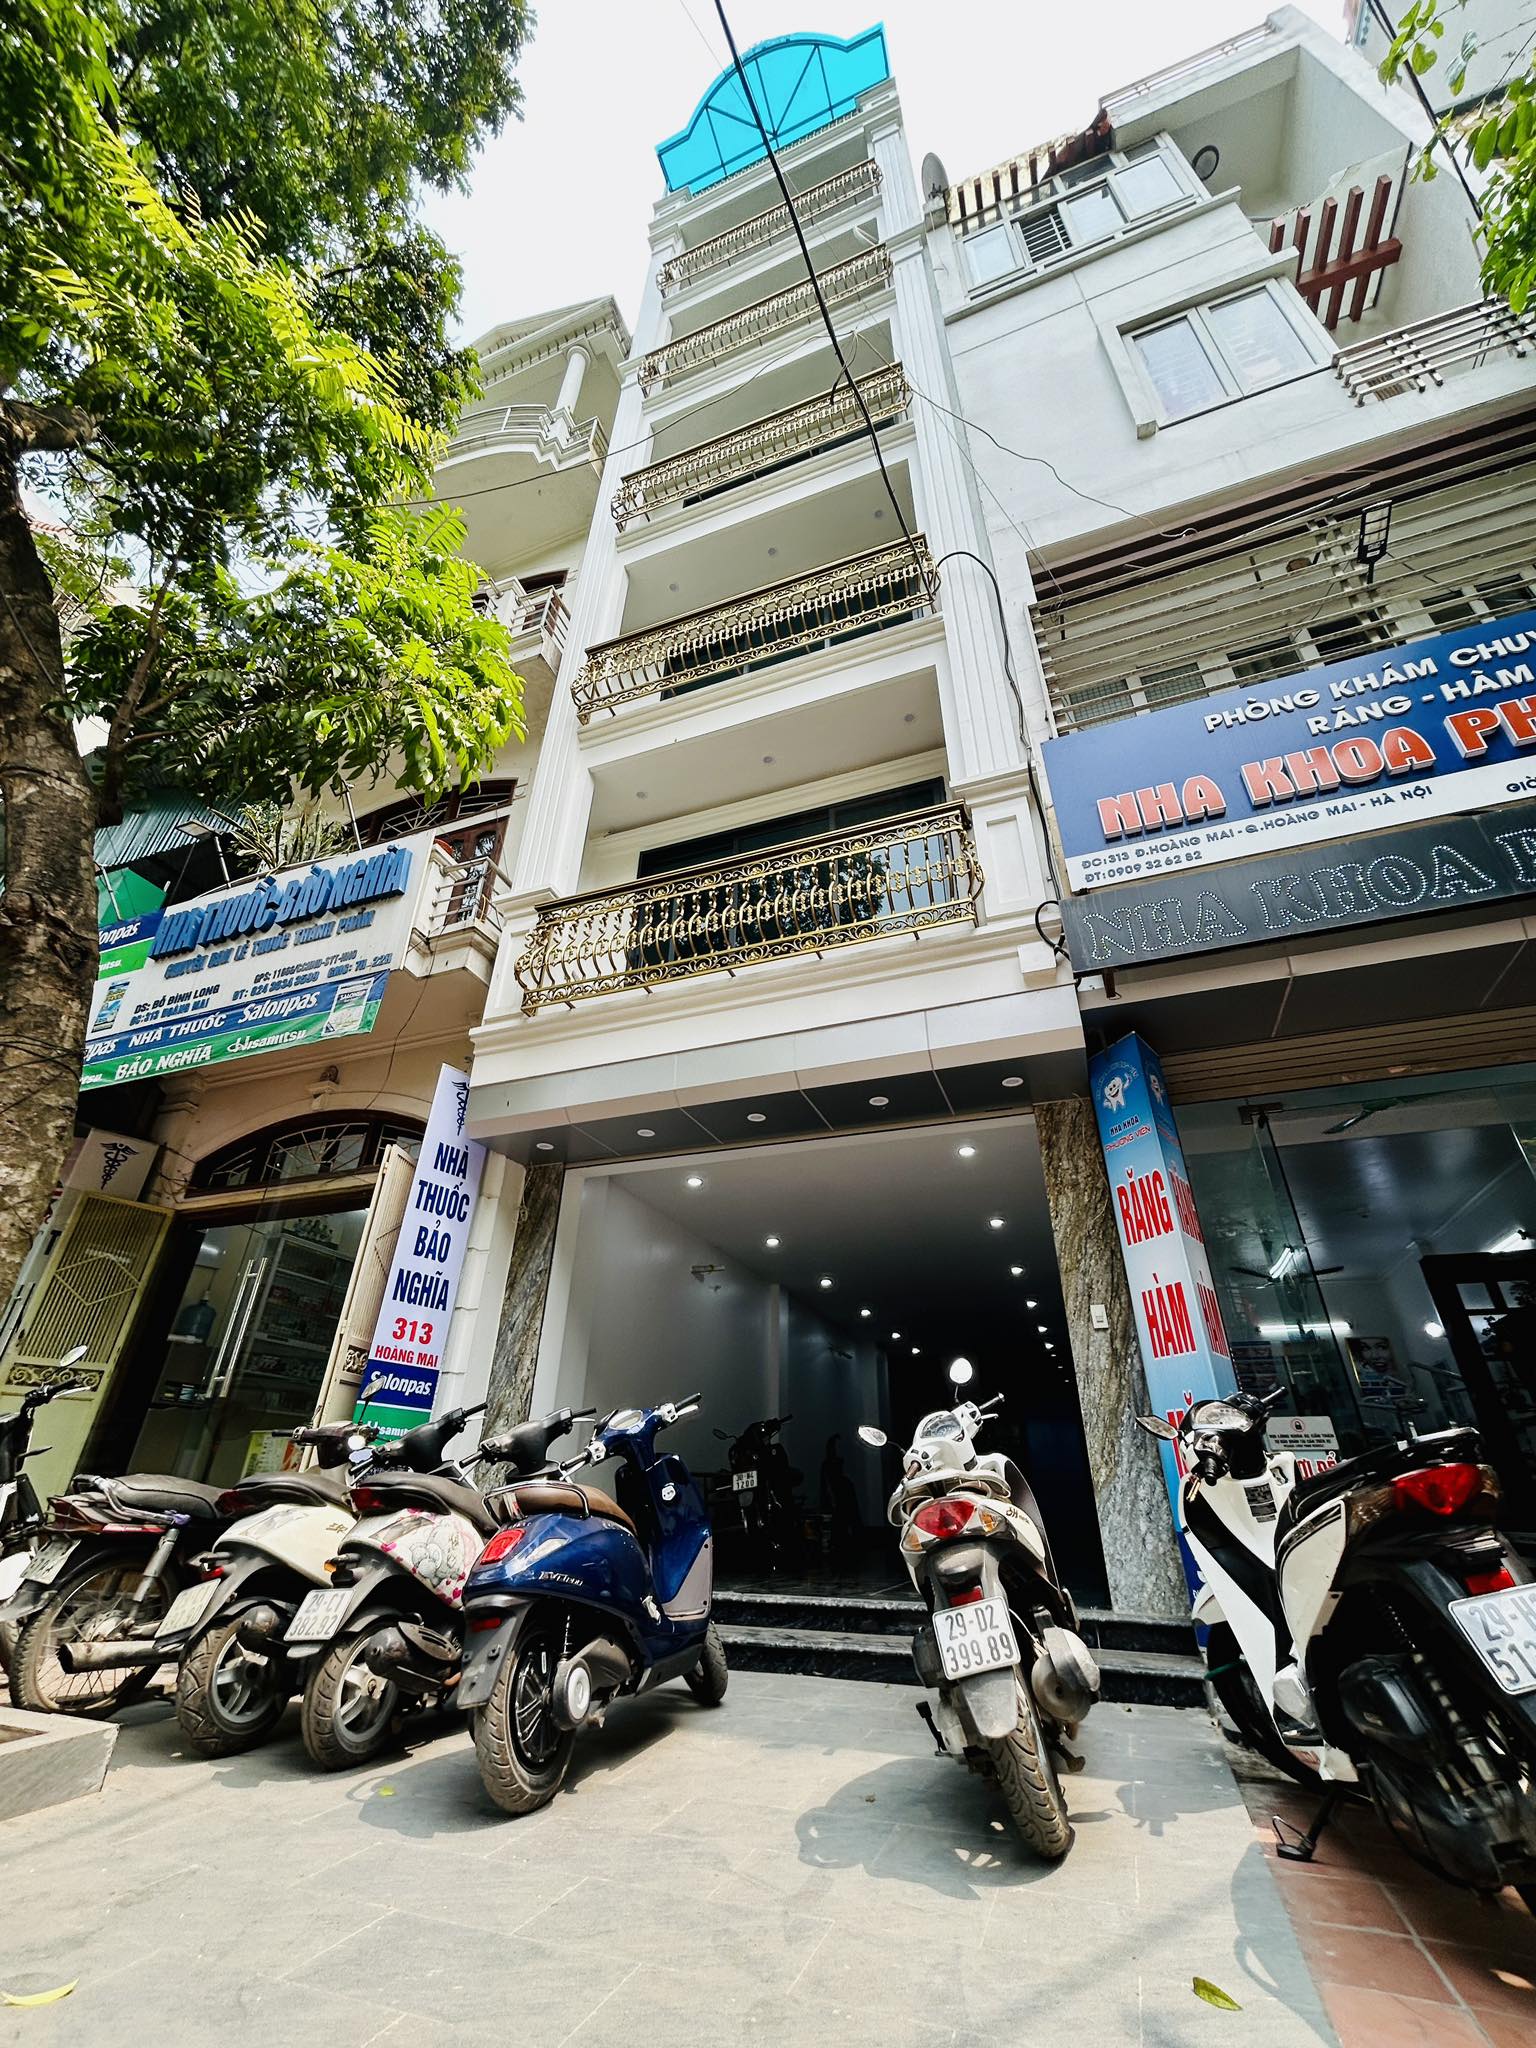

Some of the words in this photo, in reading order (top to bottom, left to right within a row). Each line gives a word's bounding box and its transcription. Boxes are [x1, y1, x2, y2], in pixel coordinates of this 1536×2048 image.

[1204, 690, 1320, 732] PHÒNG
[1329, 661, 1439, 701] KHÁM
[1309, 695, 1412, 736] RĂNG
[1097, 774, 1227, 839] NHA
[1240, 726, 1436, 805] KHOA
[1326, 802, 1357, 817] MAI
[1371, 792, 1396, 808] HÀ
[1400, 785, 1433, 801] NỘI
[1082, 891, 1248, 960] NHA
[1250, 844, 1496, 930] KHOA
[193, 984, 220, 999] LONG
[128, 1026, 162, 1048] NHÀ
[169, 1011, 227, 1038] THUỐC
[238, 991, 320, 1024] Salonpas
[115, 1055, 153, 1081] BẢO
[156, 1043, 212, 1071] NGHĨA
[433, 1137, 469, 1180] NHÀ
[415, 1181, 470, 1224] THUỐC
[1116, 1167, 1174, 1248] RĂNG
[413, 1219, 451, 1264] BẢO
[392, 1269, 450, 1312] NGHĨA
[392, 1317, 433, 1345] 313
[1141, 1272, 1197, 1359] HÀM
[375, 1344, 414, 1366] HOÀNG
[416, 1351, 439, 1367] MAI
[304, 1591, 346, 1614] 29-C1
[945, 1604, 999, 1640] 29-D2
[289, 1614, 338, 1637] 382.92
[946, 1632, 1014, 1673] 399.89
